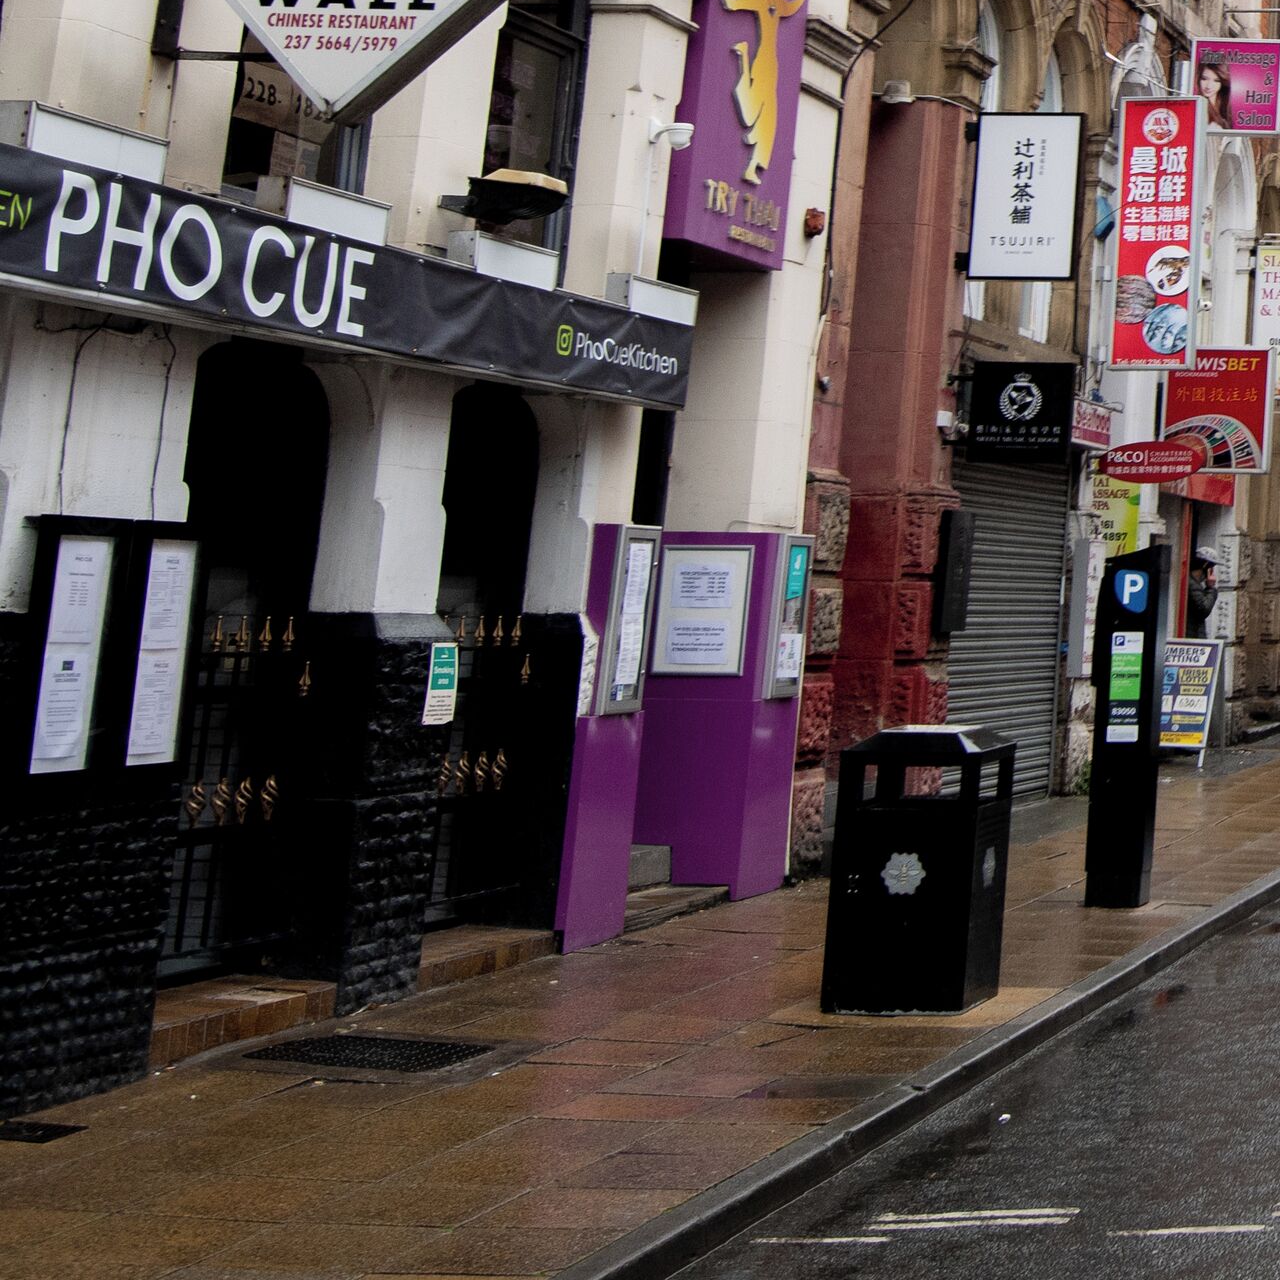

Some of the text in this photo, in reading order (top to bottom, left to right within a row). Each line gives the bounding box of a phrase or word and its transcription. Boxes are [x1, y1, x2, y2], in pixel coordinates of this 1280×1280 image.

[267, 12, 417, 30] CHINESE RESTAURANT
[284, 34, 398, 53] 237 5664/5979
[1200, 48, 1276, 68] Thai Massage
[1264, 71, 1274, 86] &
[1245, 89, 1274, 105] Hair
[1237, 111, 1272, 126] Salon
[1130, 146, 1189, 175] 曼城
[1127, 175, 1188, 203] 海鮮
[990, 236, 1051, 247] TSUJIRI
[45, 169, 376, 338] PHO CUE
[1260, 304, 1272, 316] &
[575, 332, 679, 376] PhoCueKitchen
[1107, 450, 1143, 463] P&CO
[1123, 573, 1144, 605] P
